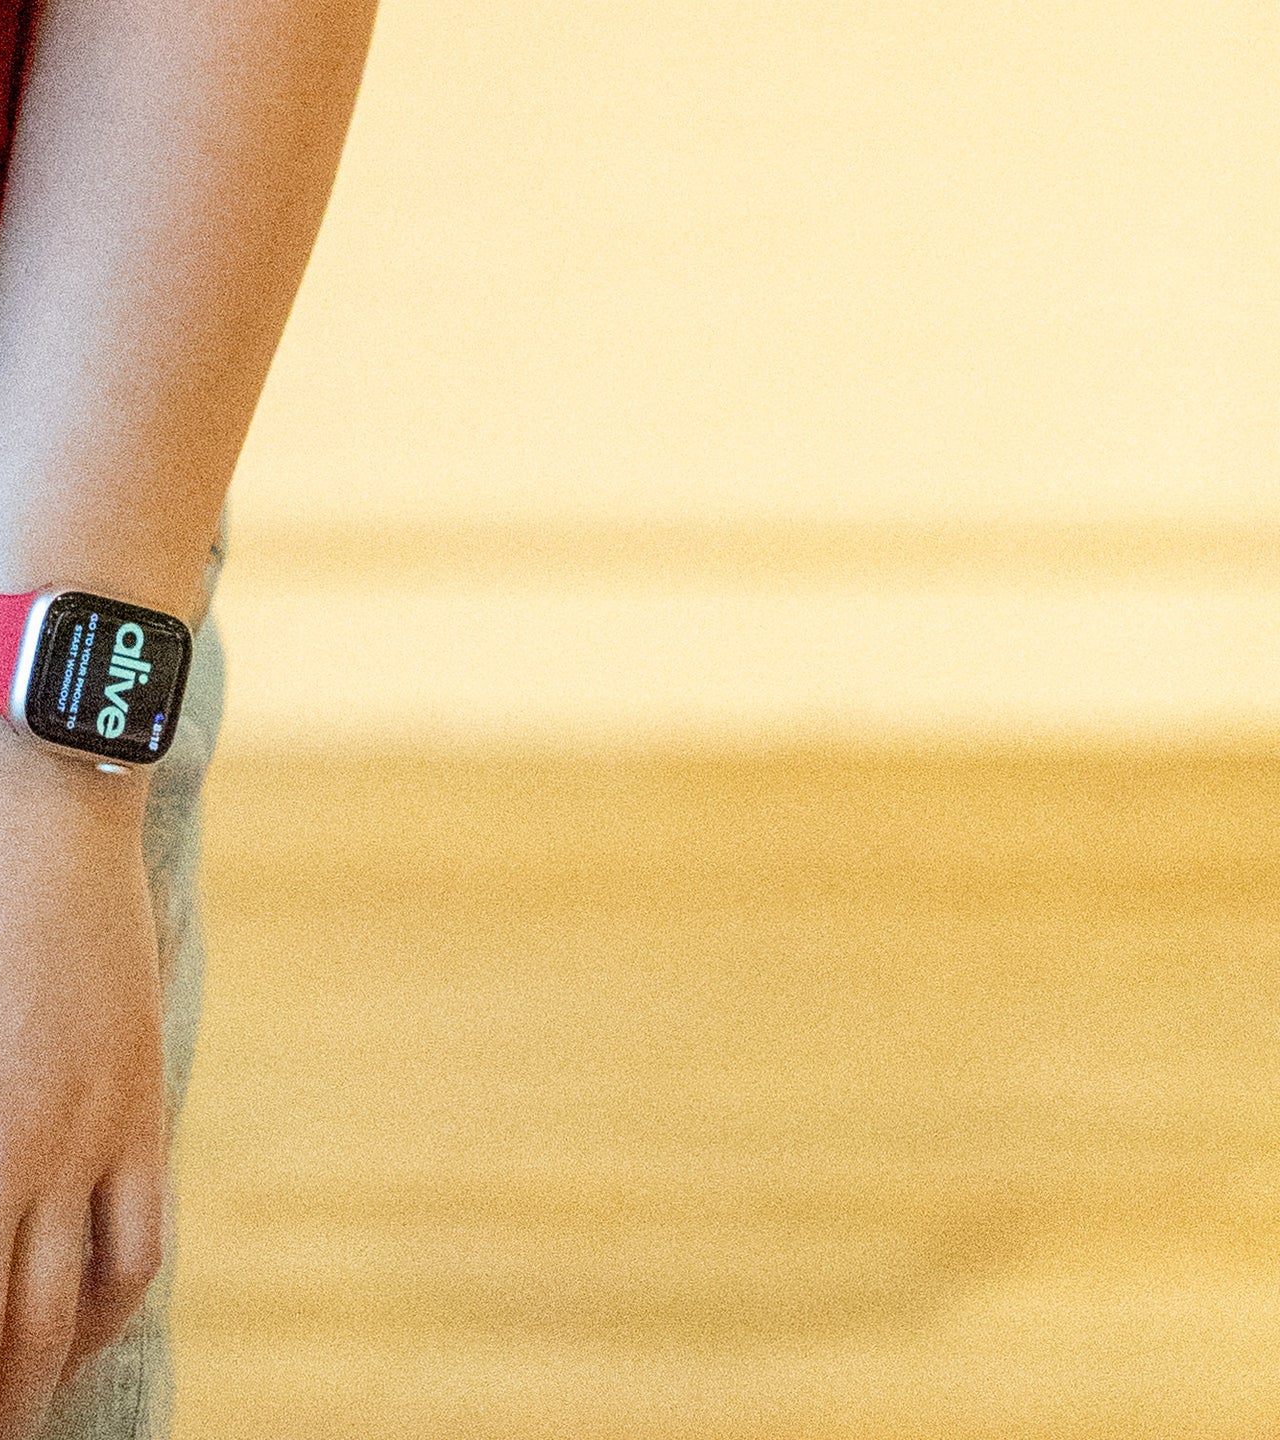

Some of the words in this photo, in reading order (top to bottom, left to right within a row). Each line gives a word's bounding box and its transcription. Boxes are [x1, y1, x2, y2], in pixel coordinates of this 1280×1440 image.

[90, 612, 99, 631] GO
[69, 624, 83, 657] START
[85, 632, 95, 647] TO
[78, 647, 91, 676] YOUR
[57, 658, 76, 713] WORKOUT
[69, 677, 85, 714] PHONE
[96, 621, 152, 739] alive
[66, 714, 77, 730] TO
